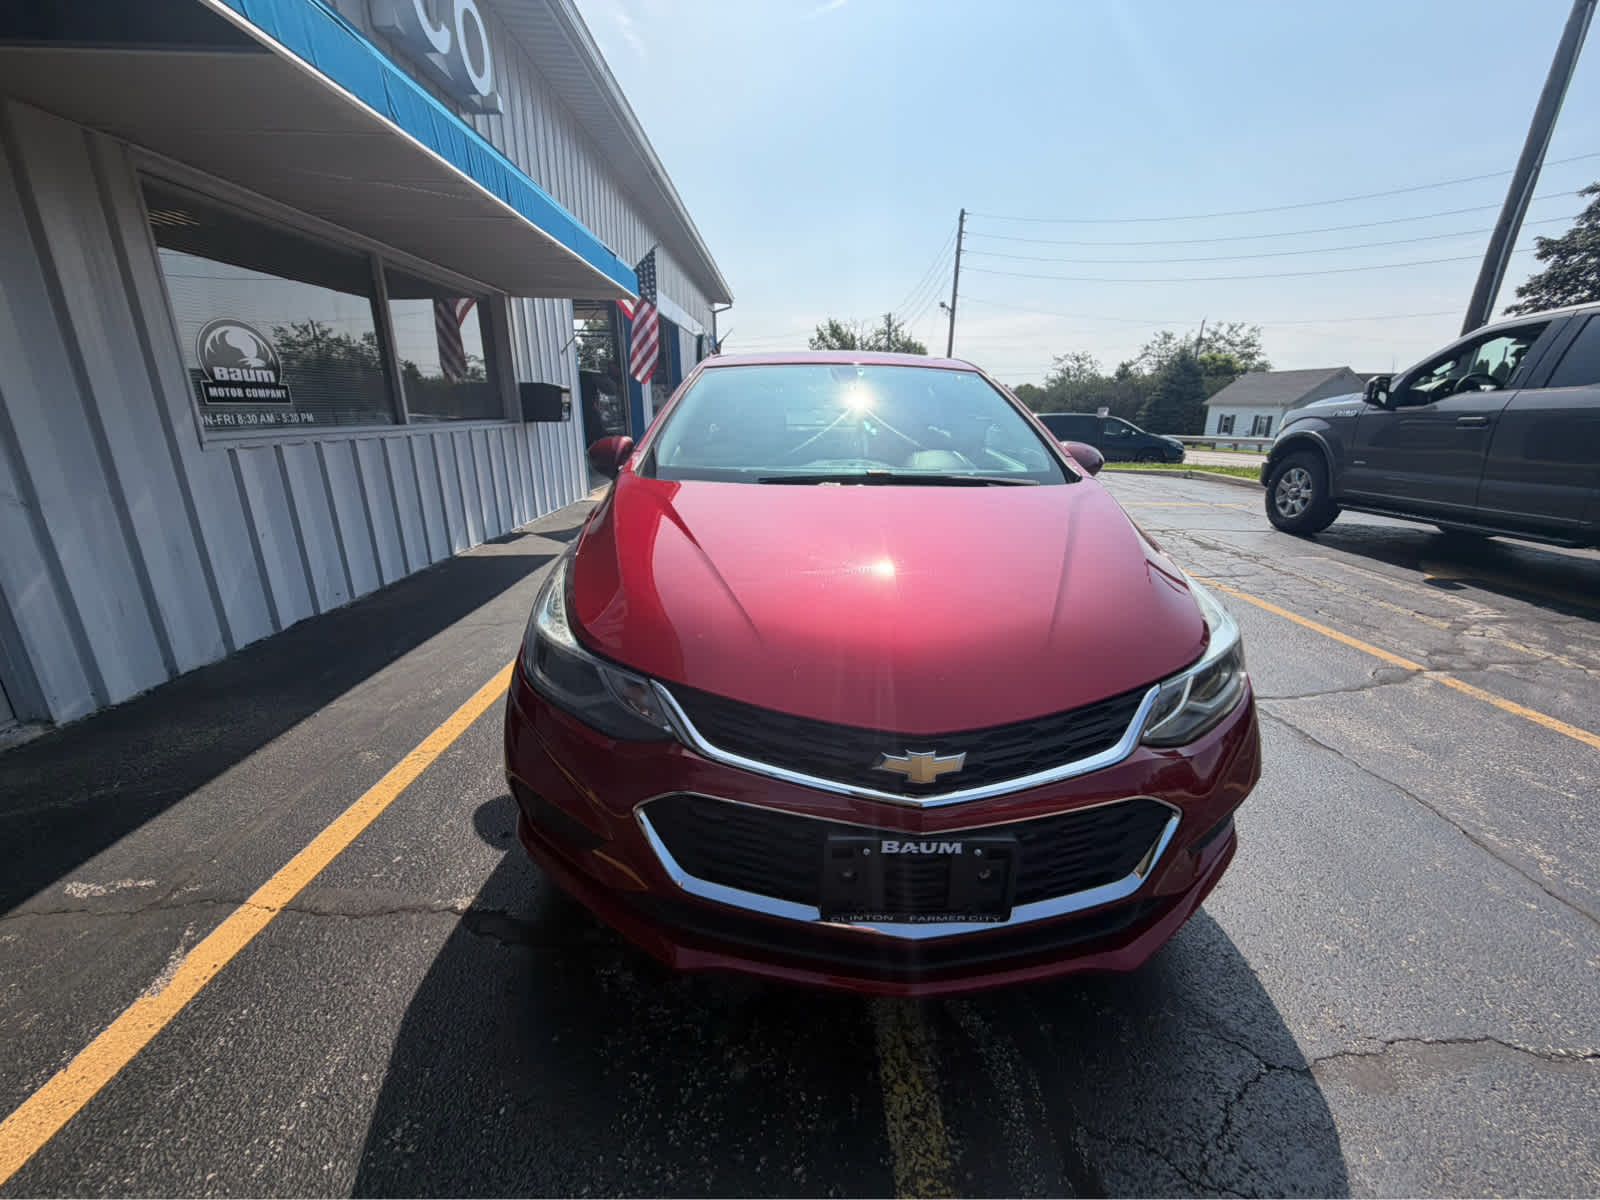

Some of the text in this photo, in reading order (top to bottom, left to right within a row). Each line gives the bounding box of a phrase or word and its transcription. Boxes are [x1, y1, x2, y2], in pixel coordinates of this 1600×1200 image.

[208, 387, 286, 399] MOTOR COMPANY
[260, 412, 275, 424] AM
[301, 412, 314, 423] PM
[881, 840, 962, 853] BAUM
[831, 914, 1001, 923] CLINTON FARMER CITY
